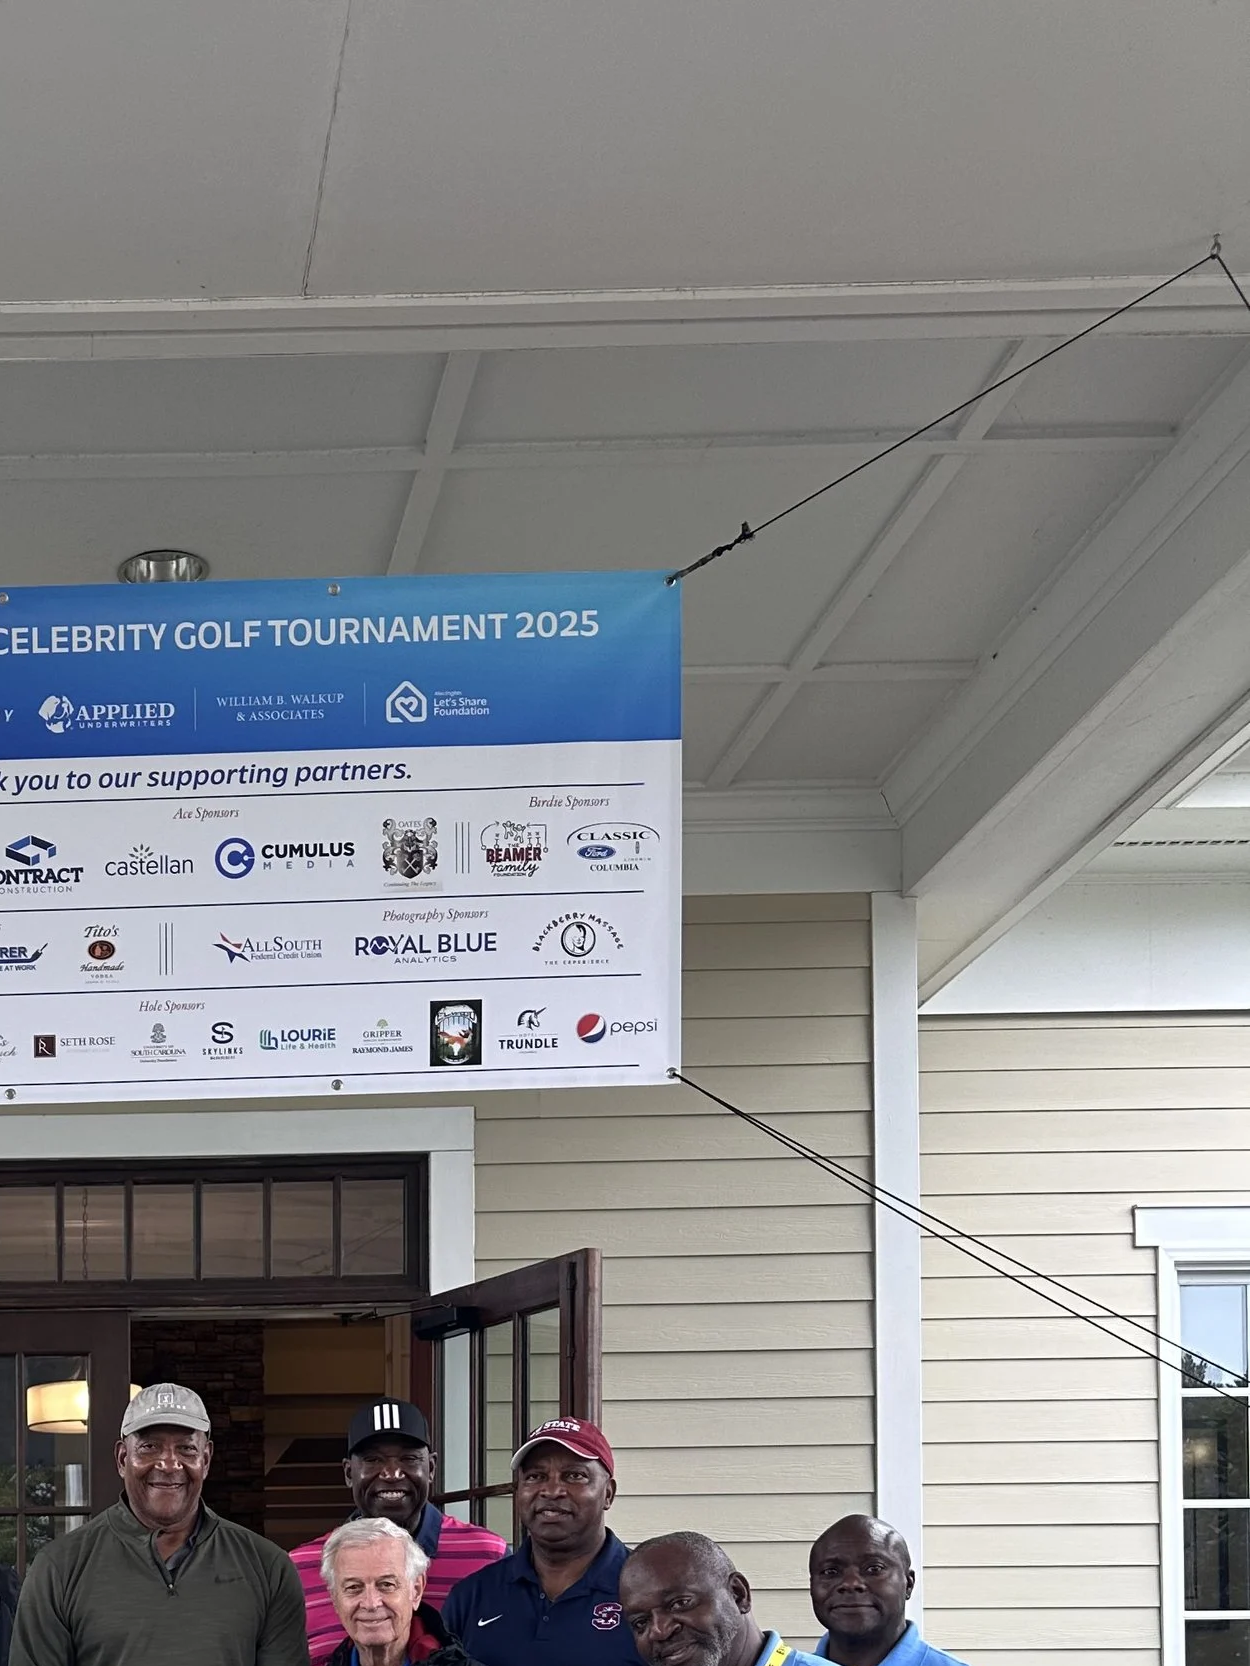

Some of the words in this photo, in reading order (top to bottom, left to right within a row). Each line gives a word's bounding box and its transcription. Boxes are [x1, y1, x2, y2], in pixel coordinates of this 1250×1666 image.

[174, 619, 261, 650] GOLF
[268, 613, 508, 648] TOURNAMENT
[516, 609, 599, 640] 2025
[216, 695, 274, 708] WILLIAM
[277, 695, 288, 706] B.
[290, 693, 344, 706] WALKUP
[433, 697, 457, 707] Let's
[458, 697, 487, 707] Share
[75, 701, 175, 721] APPLIED
[236, 711, 246, 722] &
[248, 708, 325, 722] ASSOCIATES
[433, 707, 490, 717] Foundation
[78, 719, 172, 729] UNDERWRITERS
[10, 775, 61, 796] you
[65, 769, 93, 790] to
[97, 773, 141, 789] our
[146, 763, 288, 791] supporting
[294, 762, 413, 788] partners.
[529, 796, 564, 809] Birdie
[565, 795, 610, 810] Sponsors
[172, 807, 193, 820] Ace
[196, 807, 240, 821] Sponsors
[397, 820, 422, 828] OATES
[577, 830, 650, 842] CLASSIC
[261, 840, 355, 859] CUMULUS
[486, 847, 542, 863] BEAMER
[584, 846, 609, 858] Ford
[105, 855, 193, 876] castellan
[263, 859, 354, 870] MEDIA
[589, 863, 639, 872] COLUMBIA
[383, 909, 445, 923] Photography
[447, 908, 489, 921] Sponsors
[84, 925, 119, 938] Tito's
[532, 912, 586, 952] BLACKBERRY
[588, 914, 624, 950] MASSAGE
[355, 934, 431, 956] ROYAL
[438, 932, 497, 953] BLUE
[250, 952, 276, 960] Federal
[277, 952, 299, 960] Credit
[300, 951, 322, 959] Union
[394, 955, 457, 964] ANALYTICS
[80, 961, 124, 973] Handmade
[139, 1000, 163, 1012] Hole
[164, 1000, 205, 1013] Sponsors
[610, 1018, 658, 1036] pepsi
[363, 1029, 402, 1039] GRIPPER
[60, 1037, 87, 1047] SETH
[89, 1036, 116, 1046] ROSE
[281, 1042, 298, 1050] Life
[307, 1041, 336, 1050] Health
[498, 1038, 558, 1049] TRUNDLE
[130, 1049, 153, 1057] SOUTH
[154, 1048, 187, 1056] CAROLINA
[202, 1046, 243, 1056] SKYLINKS
[352, 1046, 389, 1054] RAYMOND
[389, 1045, 413, 1053] JAMES
[543, 1420, 581, 1432] STATE
